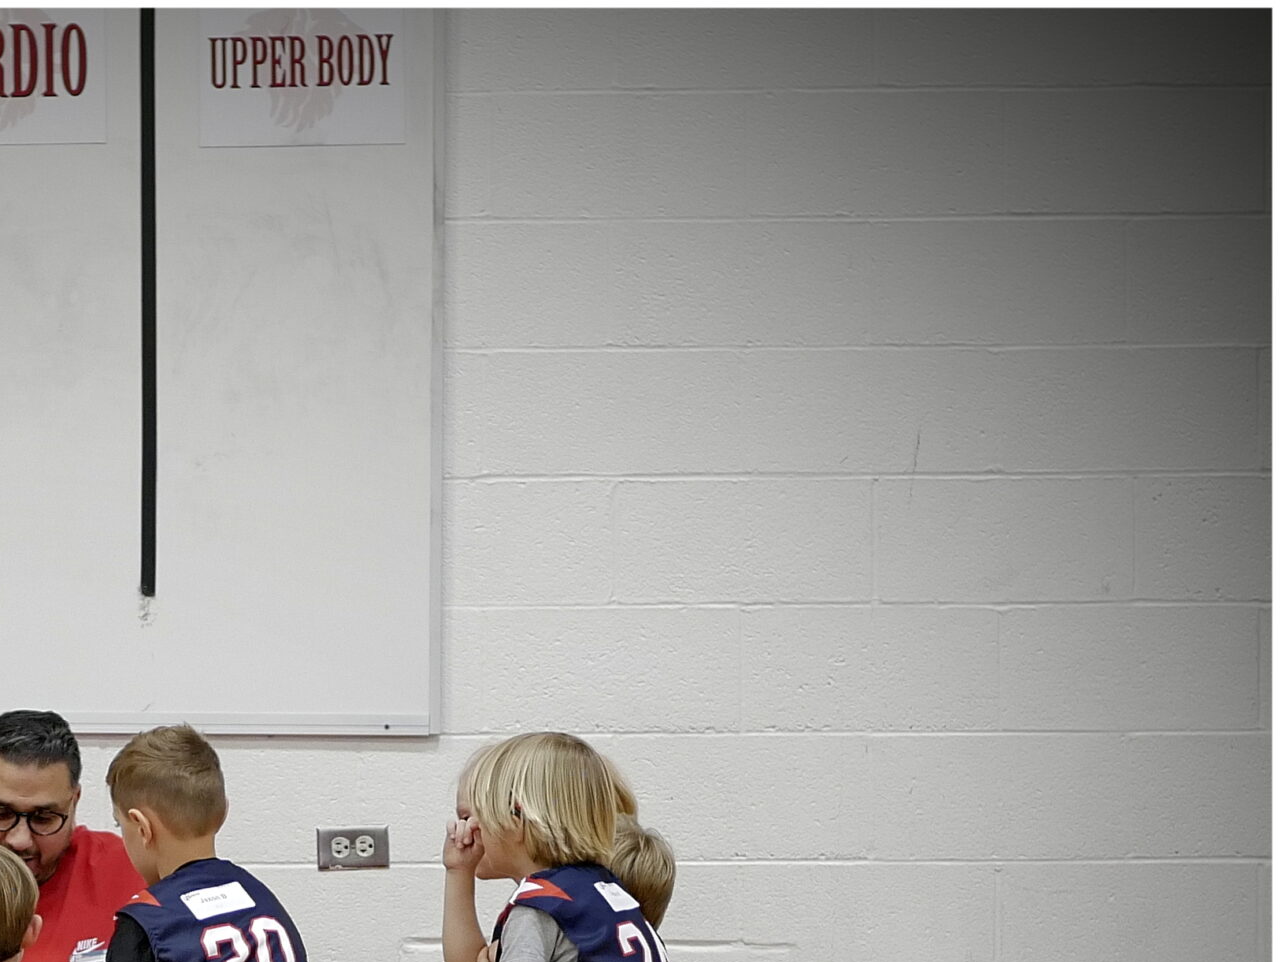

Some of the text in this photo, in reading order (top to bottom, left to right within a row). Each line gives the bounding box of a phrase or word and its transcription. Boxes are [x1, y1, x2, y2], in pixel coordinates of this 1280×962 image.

[208, 34, 394, 89] UPPER BODY
[76, 937, 98, 950] NIKE
